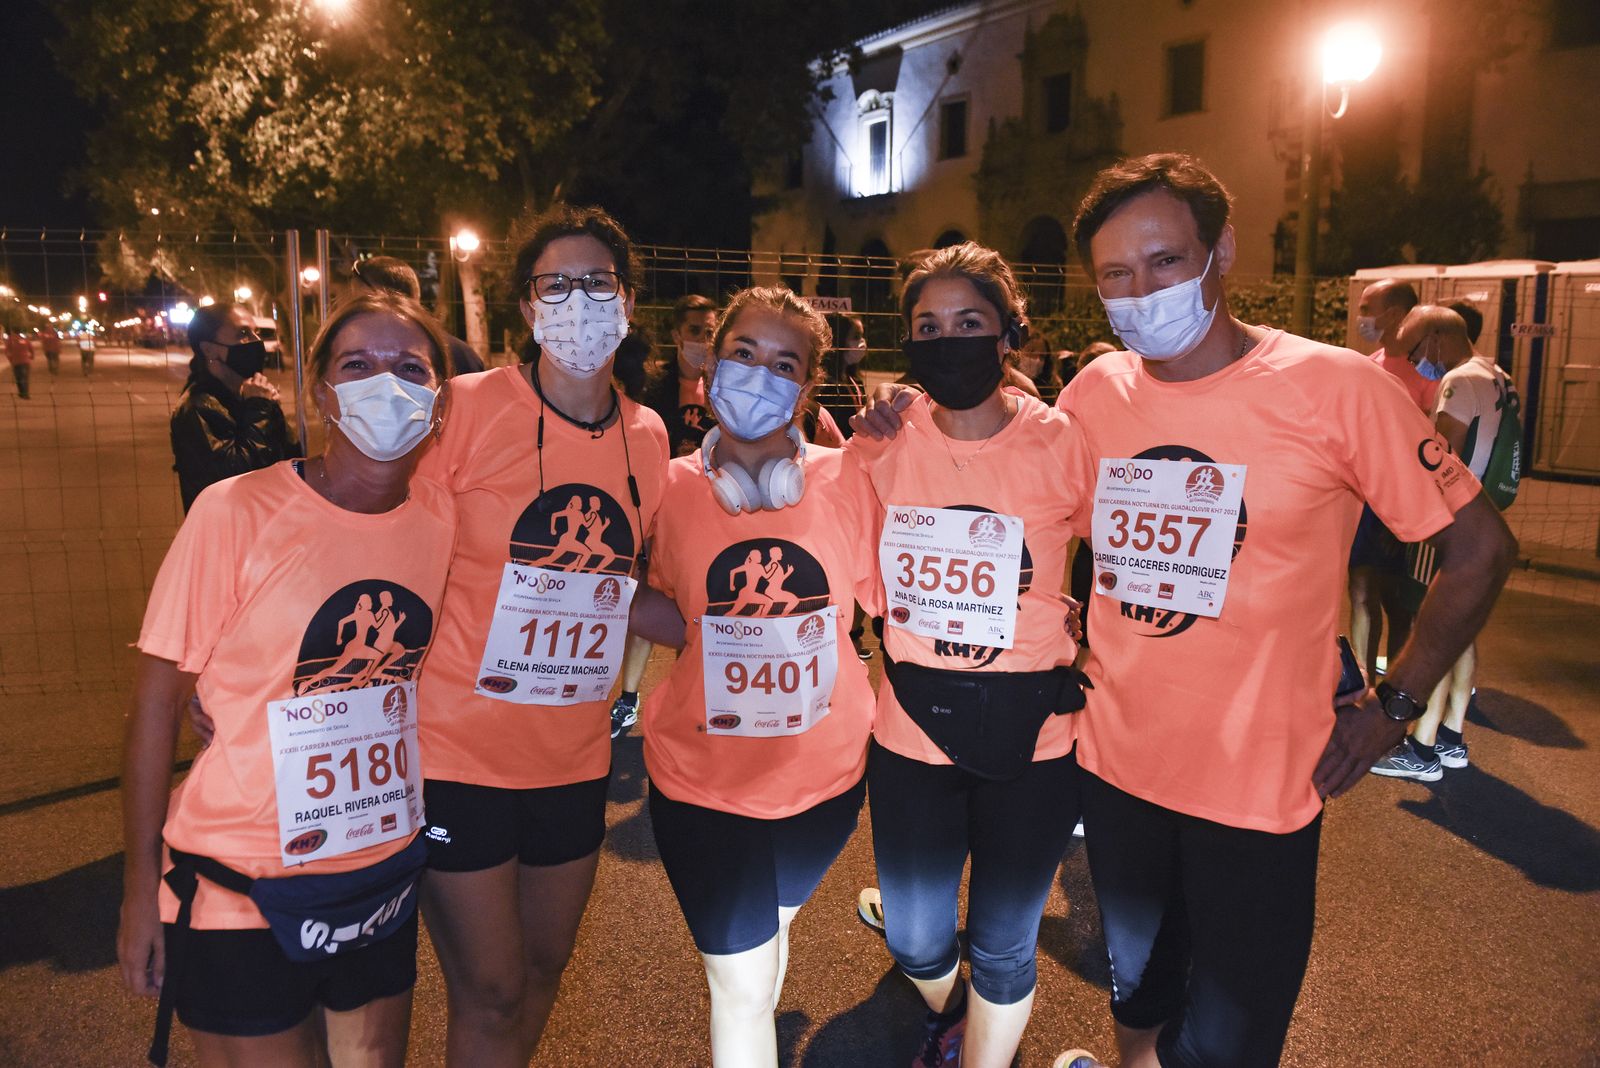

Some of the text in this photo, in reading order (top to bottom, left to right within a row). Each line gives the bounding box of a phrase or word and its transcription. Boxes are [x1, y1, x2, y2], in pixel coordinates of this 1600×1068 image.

[808, 300, 848, 311] EMSA
[1171, 504, 1210, 513] GUADALQUIVIR
[1108, 509, 1211, 557] 3557
[1095, 552, 1126, 566] CARMELO
[1128, 557, 1170, 572] CACERES
[1172, 564, 1226, 580] RODRIGUEZ
[896, 552, 995, 598] 3556
[1127, 581, 1152, 594] Coca-Cola
[1197, 590, 1214, 599] ABC
[895, 591, 908, 600] ANA
[909, 594, 917, 603] DE
[917, 597, 926, 606] LA
[929, 599, 953, 610] ROSA
[956, 602, 1003, 615] MARTÍNEZ
[518, 607, 541, 615] CARRERA
[542, 609, 569, 617] NOCTURNA
[919, 619, 940, 630] Coca-Cola
[520, 618, 608, 658] 1112
[497, 659, 529, 672] ELENA
[531, 662, 570, 674] RÍSQUEZ
[571, 665, 609, 675] MACHADO
[725, 655, 818, 694] 9401
[530, 686, 557, 696] Coca-Cola
[754, 720, 780, 728] Coca-Cola
[300, 741, 330, 752] CARRERA
[331, 736, 363, 747] NOCTURNA
[306, 738, 407, 799] 5180
[295, 804, 342, 823] RAQUEL
[344, 796, 380, 813] RIVERA
[346, 823, 375, 840] Coca-Cola
